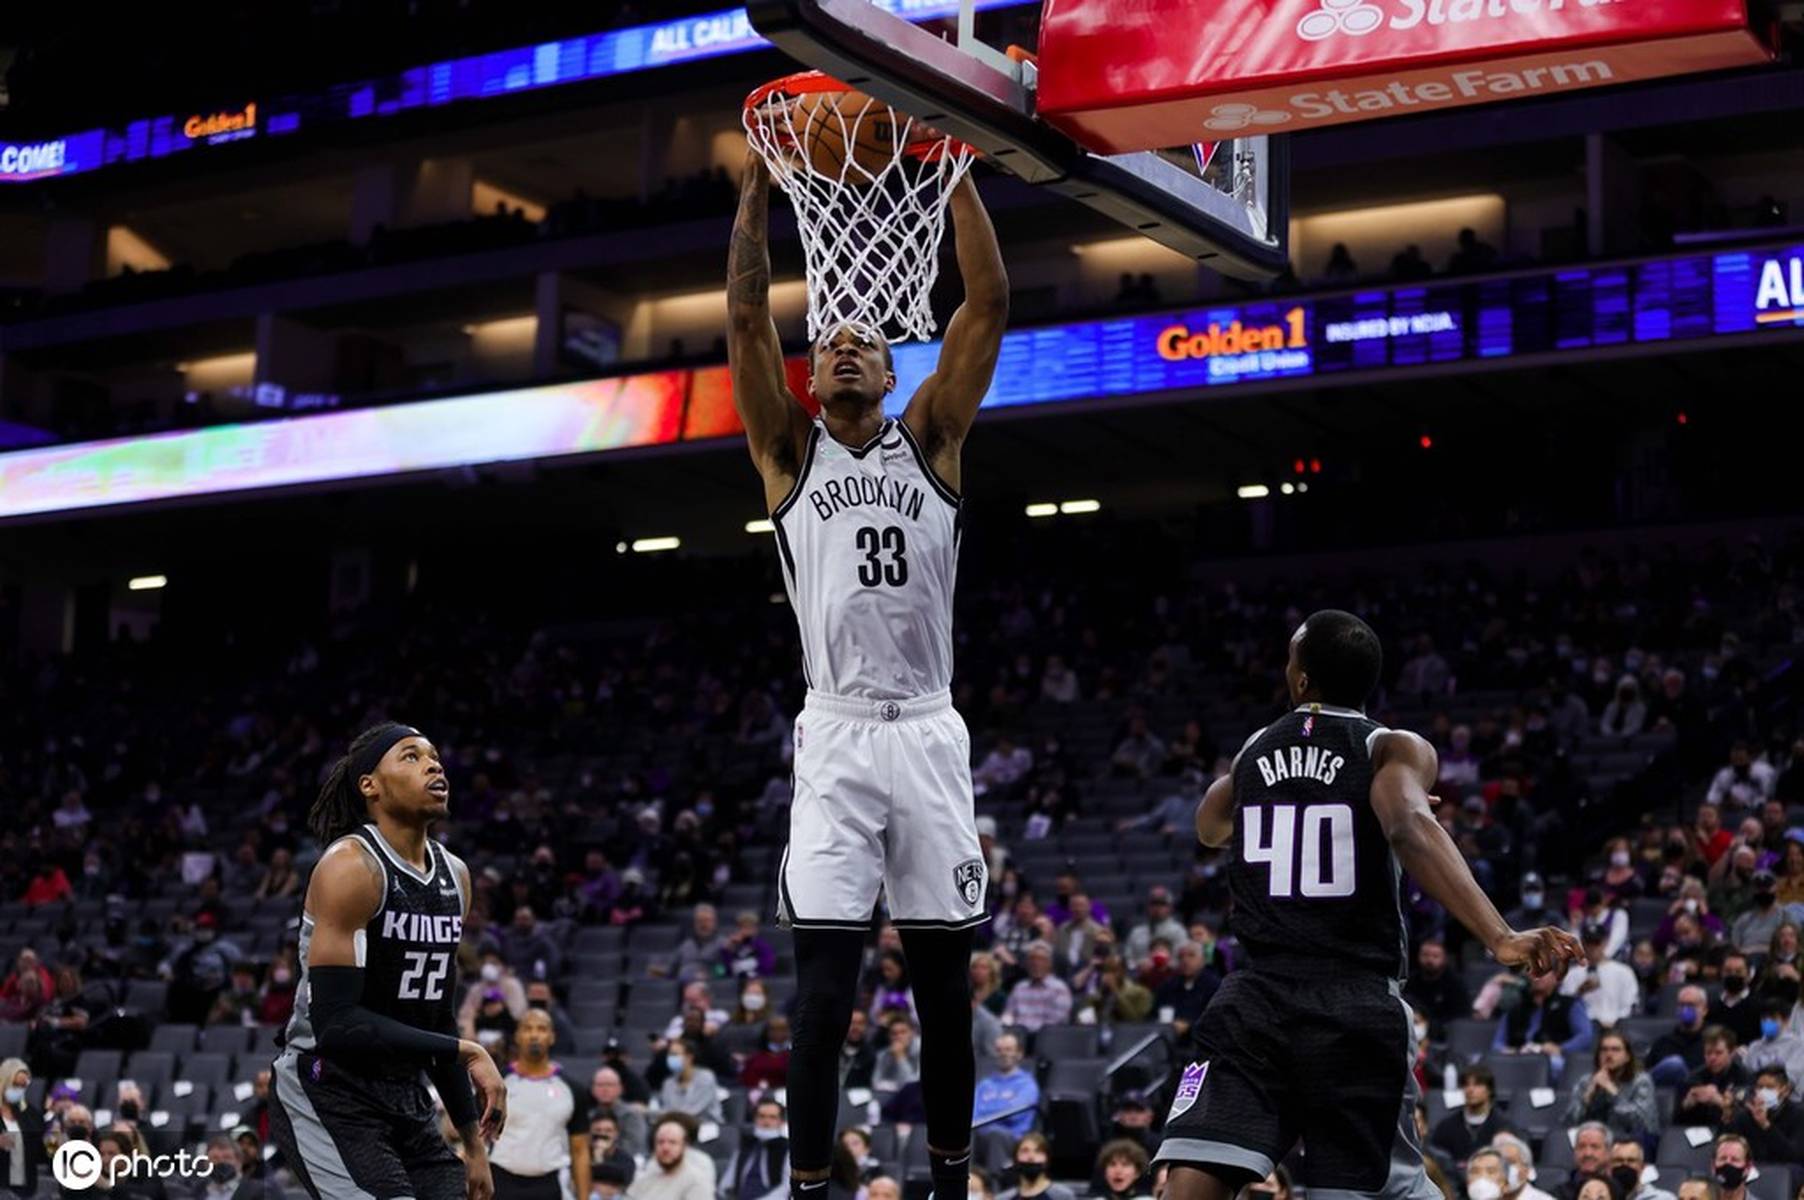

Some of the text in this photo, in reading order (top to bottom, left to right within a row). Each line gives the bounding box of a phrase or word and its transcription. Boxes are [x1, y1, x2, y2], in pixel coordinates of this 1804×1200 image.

[809, 475, 925, 522] BROOKLYN
[856, 526, 908, 587] 33
[1256, 746, 1345, 787] BARNES
[1243, 804, 1356, 898] 40
[382, 910, 462, 943] KINGS
[398, 951, 450, 1000] 22
